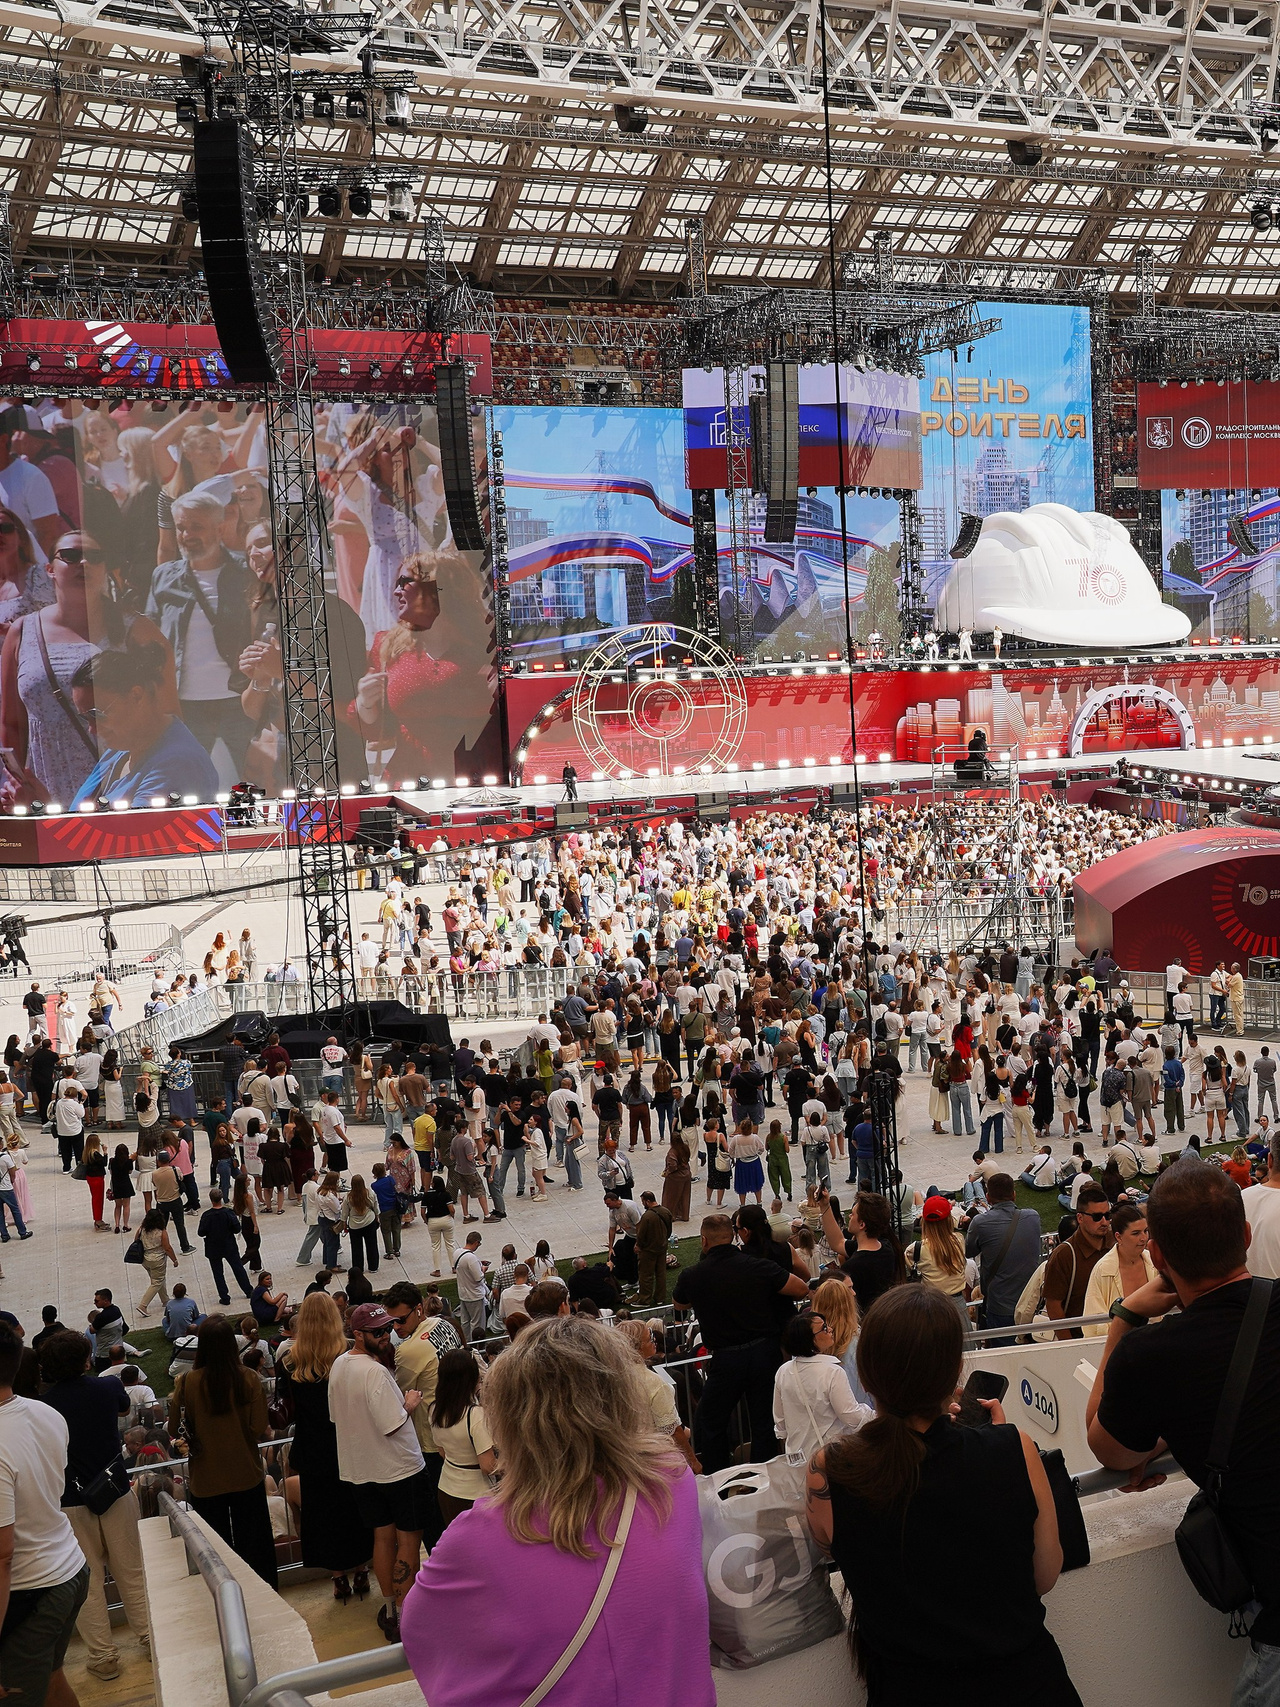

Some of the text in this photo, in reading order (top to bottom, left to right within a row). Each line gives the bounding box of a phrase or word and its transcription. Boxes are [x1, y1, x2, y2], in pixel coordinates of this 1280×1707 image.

[930, 377, 1030, 403] ДЕНЬ
[920, 411, 1086, 438] РОИТЕЛЯ
[1238, 883, 1268, 906] 70
[1024, 1384, 1054, 1421] A 104
[707, 1515, 812, 1609] GJ
